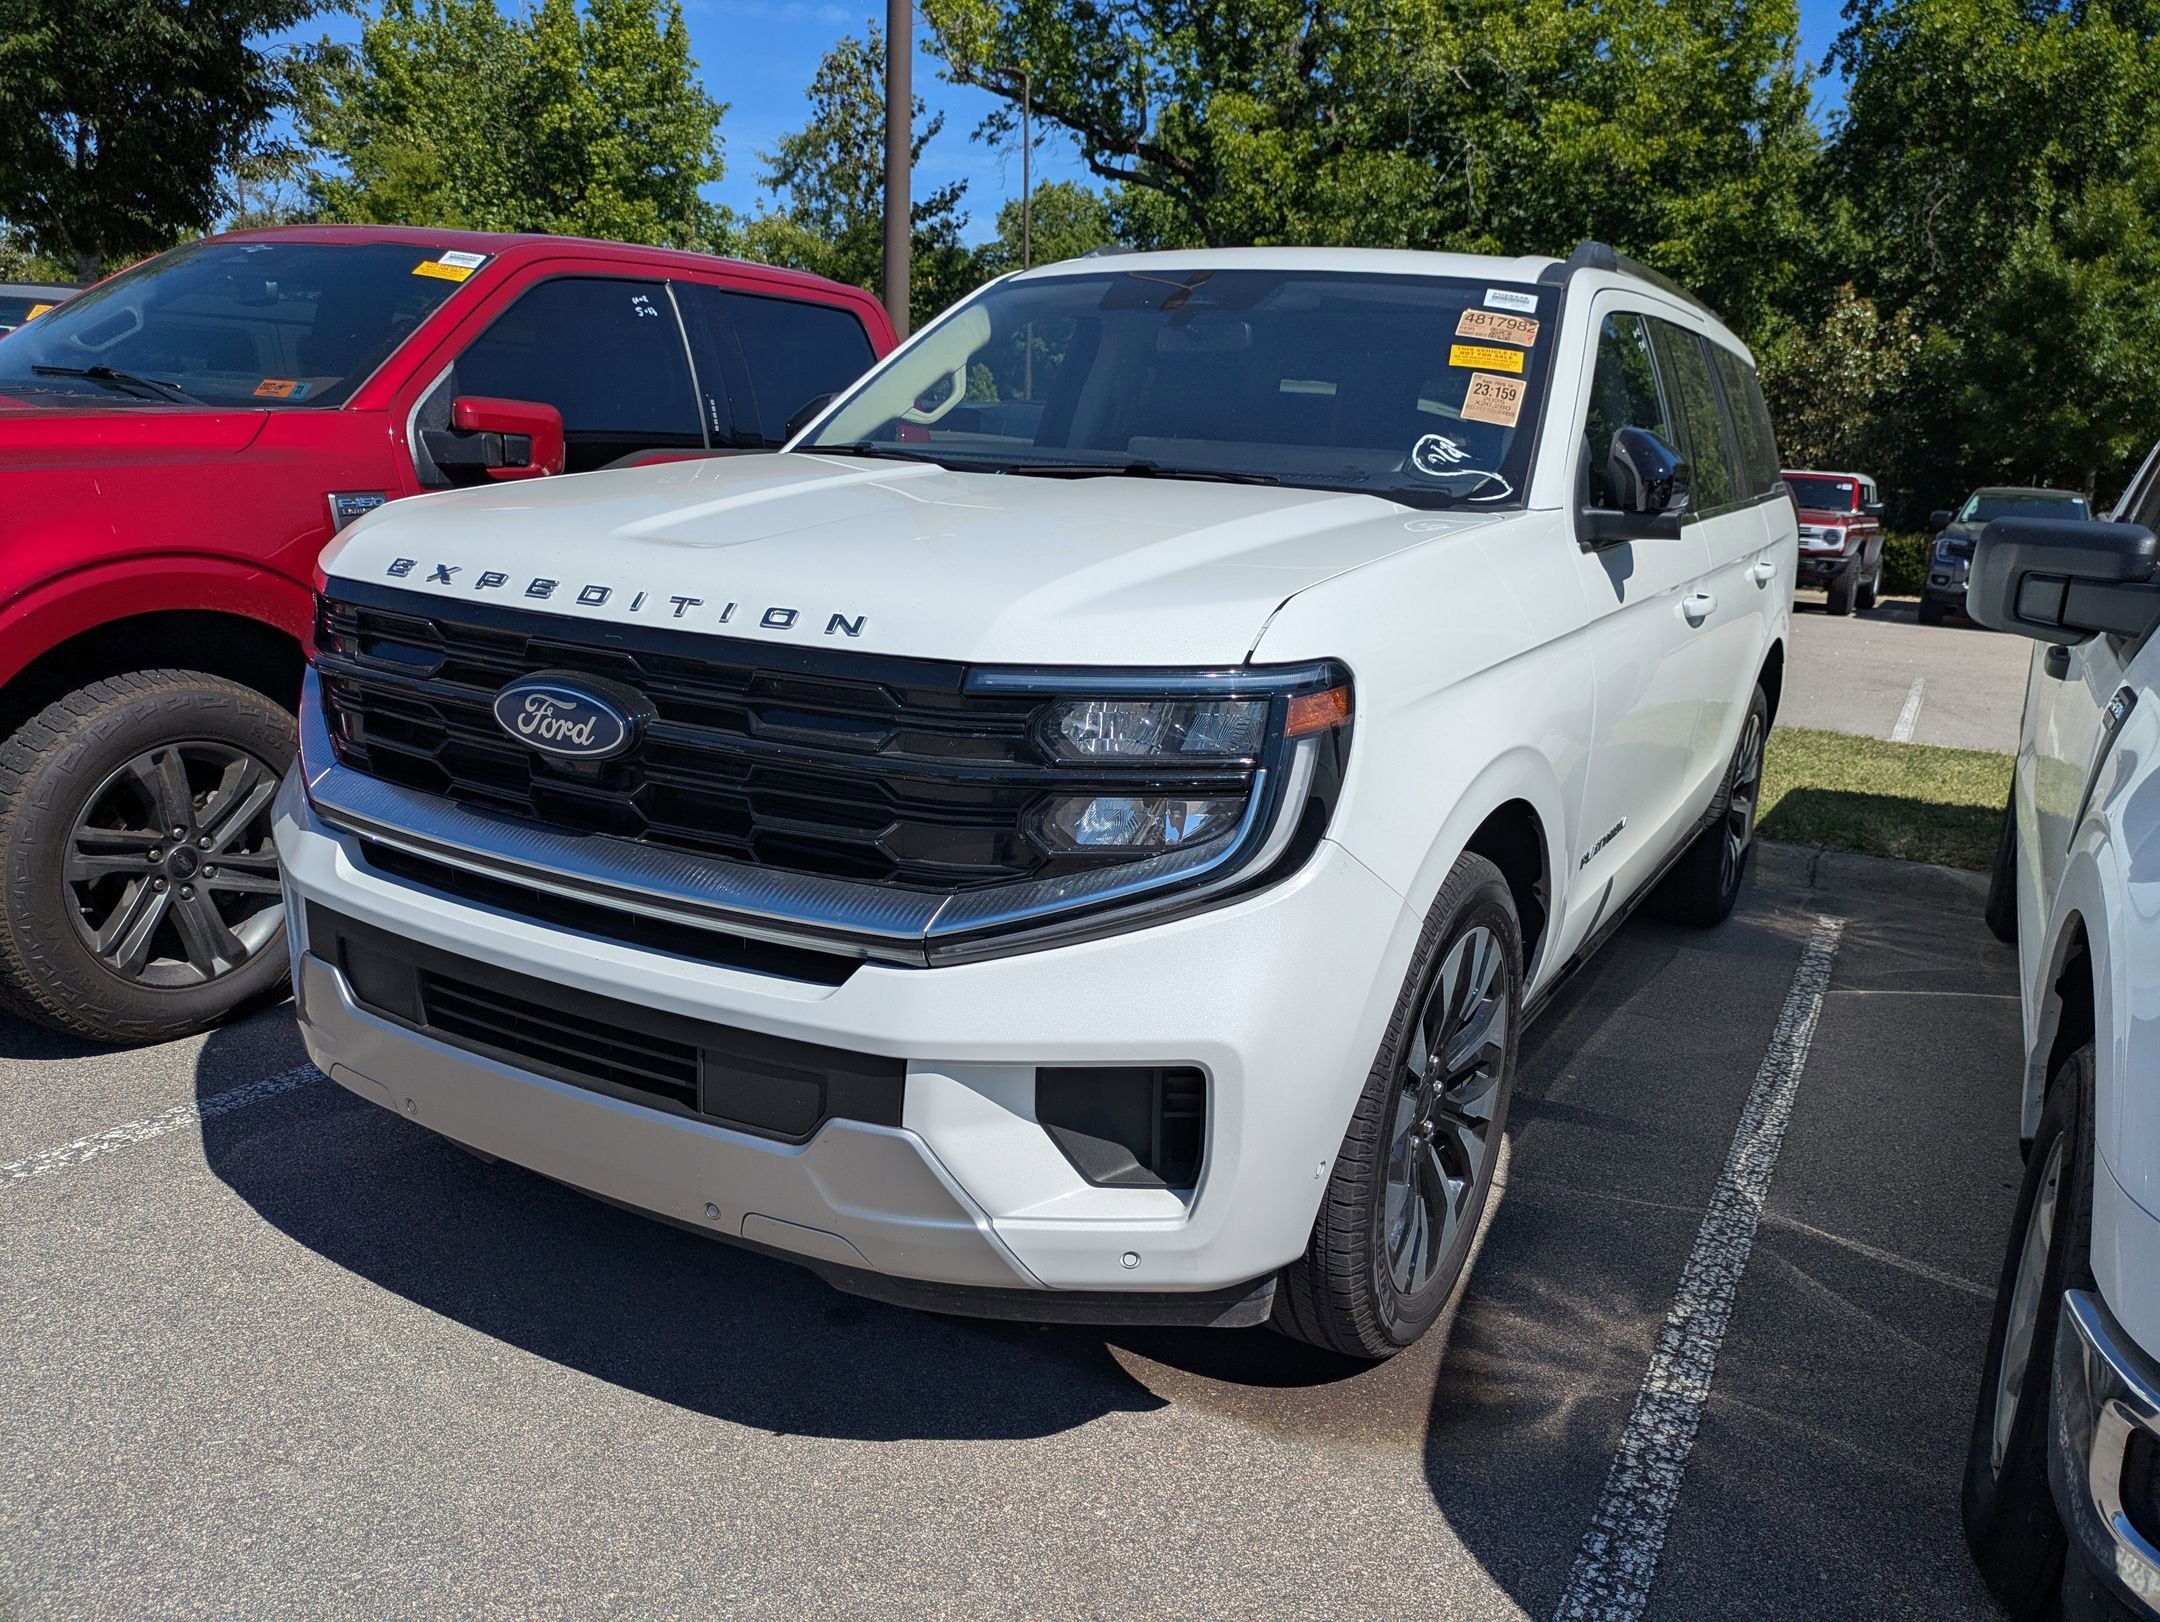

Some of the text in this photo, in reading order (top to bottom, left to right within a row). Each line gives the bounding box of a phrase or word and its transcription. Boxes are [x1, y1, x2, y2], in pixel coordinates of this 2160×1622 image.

[1465, 313, 1536, 334] 4817982
[1473, 382, 1517, 402] 23:159
[337, 496, 386, 508] F-150
[386, 557, 868, 638] EXPEDITION
[517, 693, 597, 747] Ford
